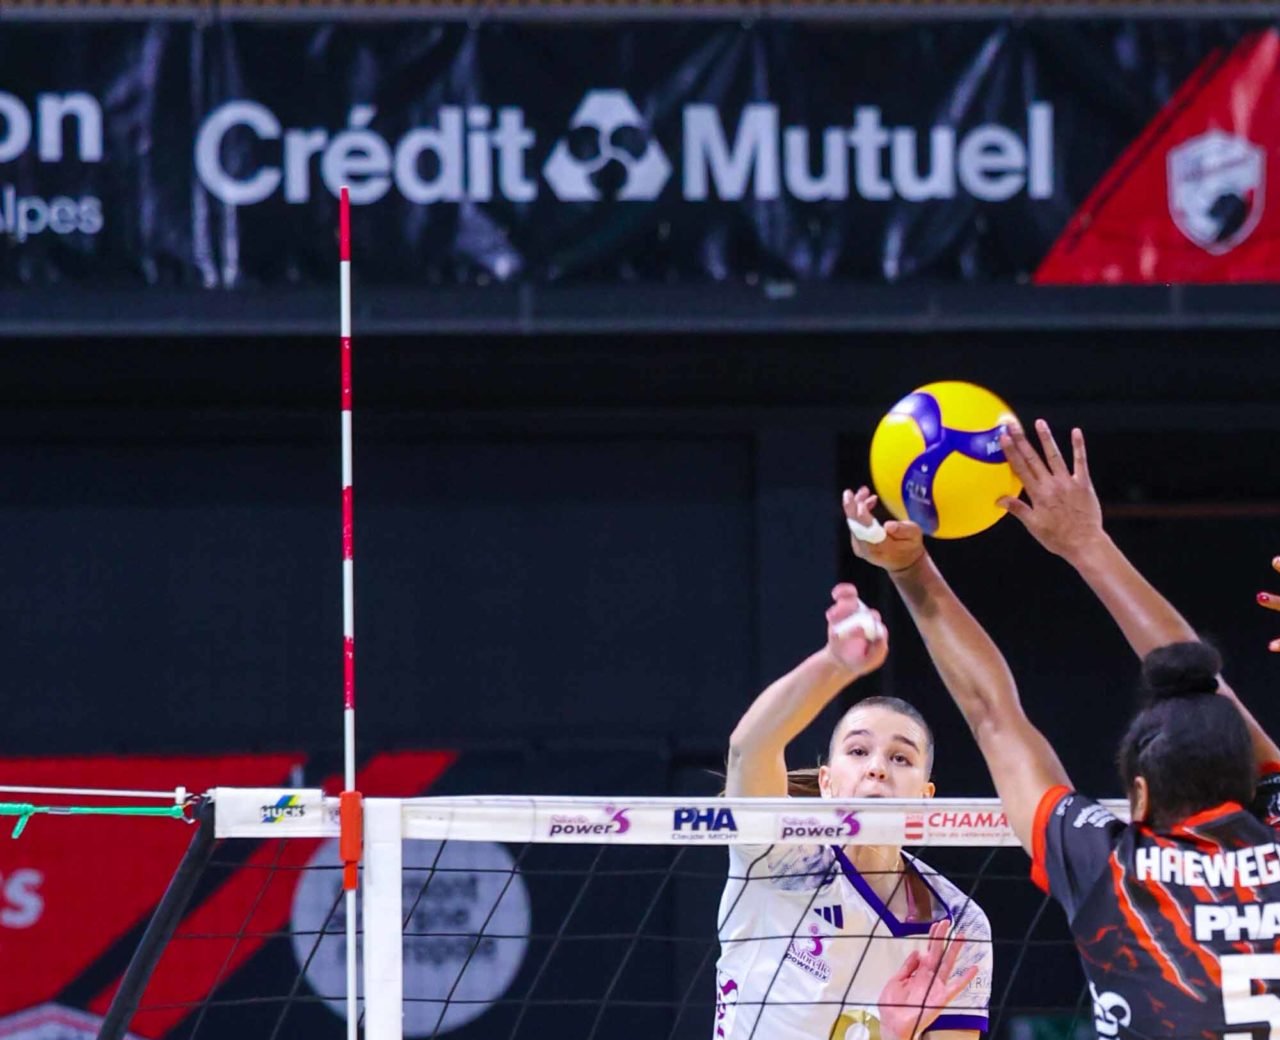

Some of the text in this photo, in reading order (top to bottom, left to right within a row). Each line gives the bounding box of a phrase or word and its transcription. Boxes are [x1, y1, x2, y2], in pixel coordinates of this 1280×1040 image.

[197, 100, 535, 203] Crédit
[682, 102, 1055, 201] Mutuel
[0, 188, 102, 241] lpes
[673, 807, 738, 831] PHA
